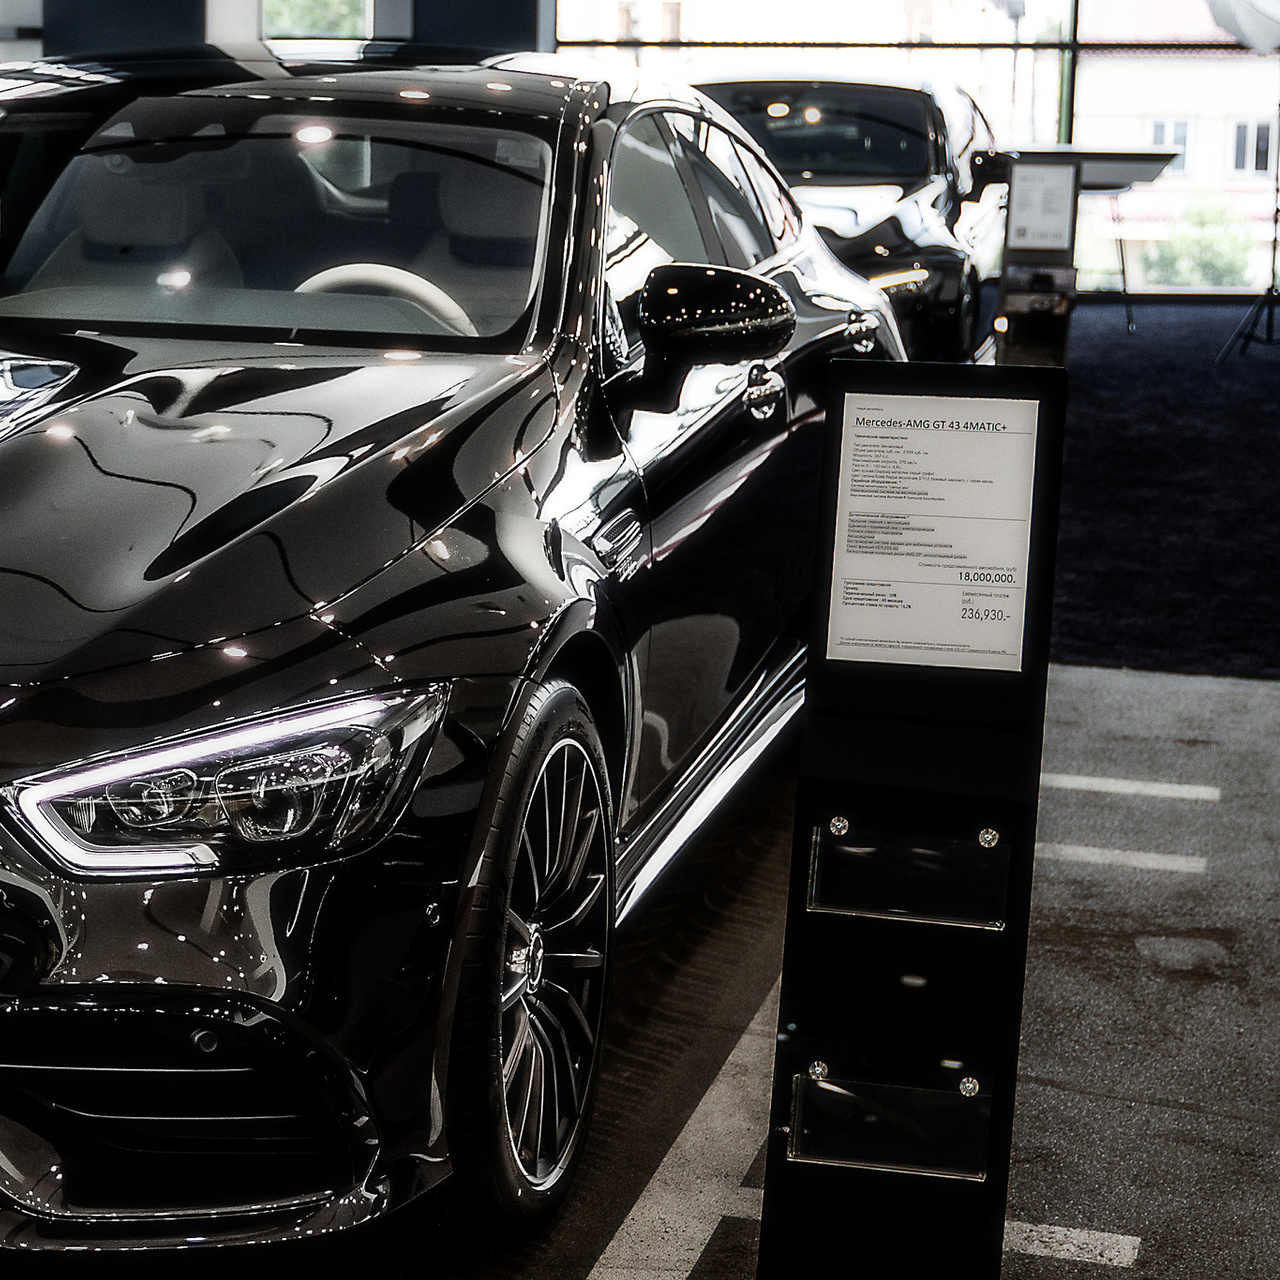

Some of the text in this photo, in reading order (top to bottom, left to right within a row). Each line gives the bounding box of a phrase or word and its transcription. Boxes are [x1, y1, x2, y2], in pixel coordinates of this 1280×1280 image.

[855, 416, 1008, 432] Mercedes-AMG GT 43 4MATIC+
[958, 571, 1017, 584] 18,000,000.
